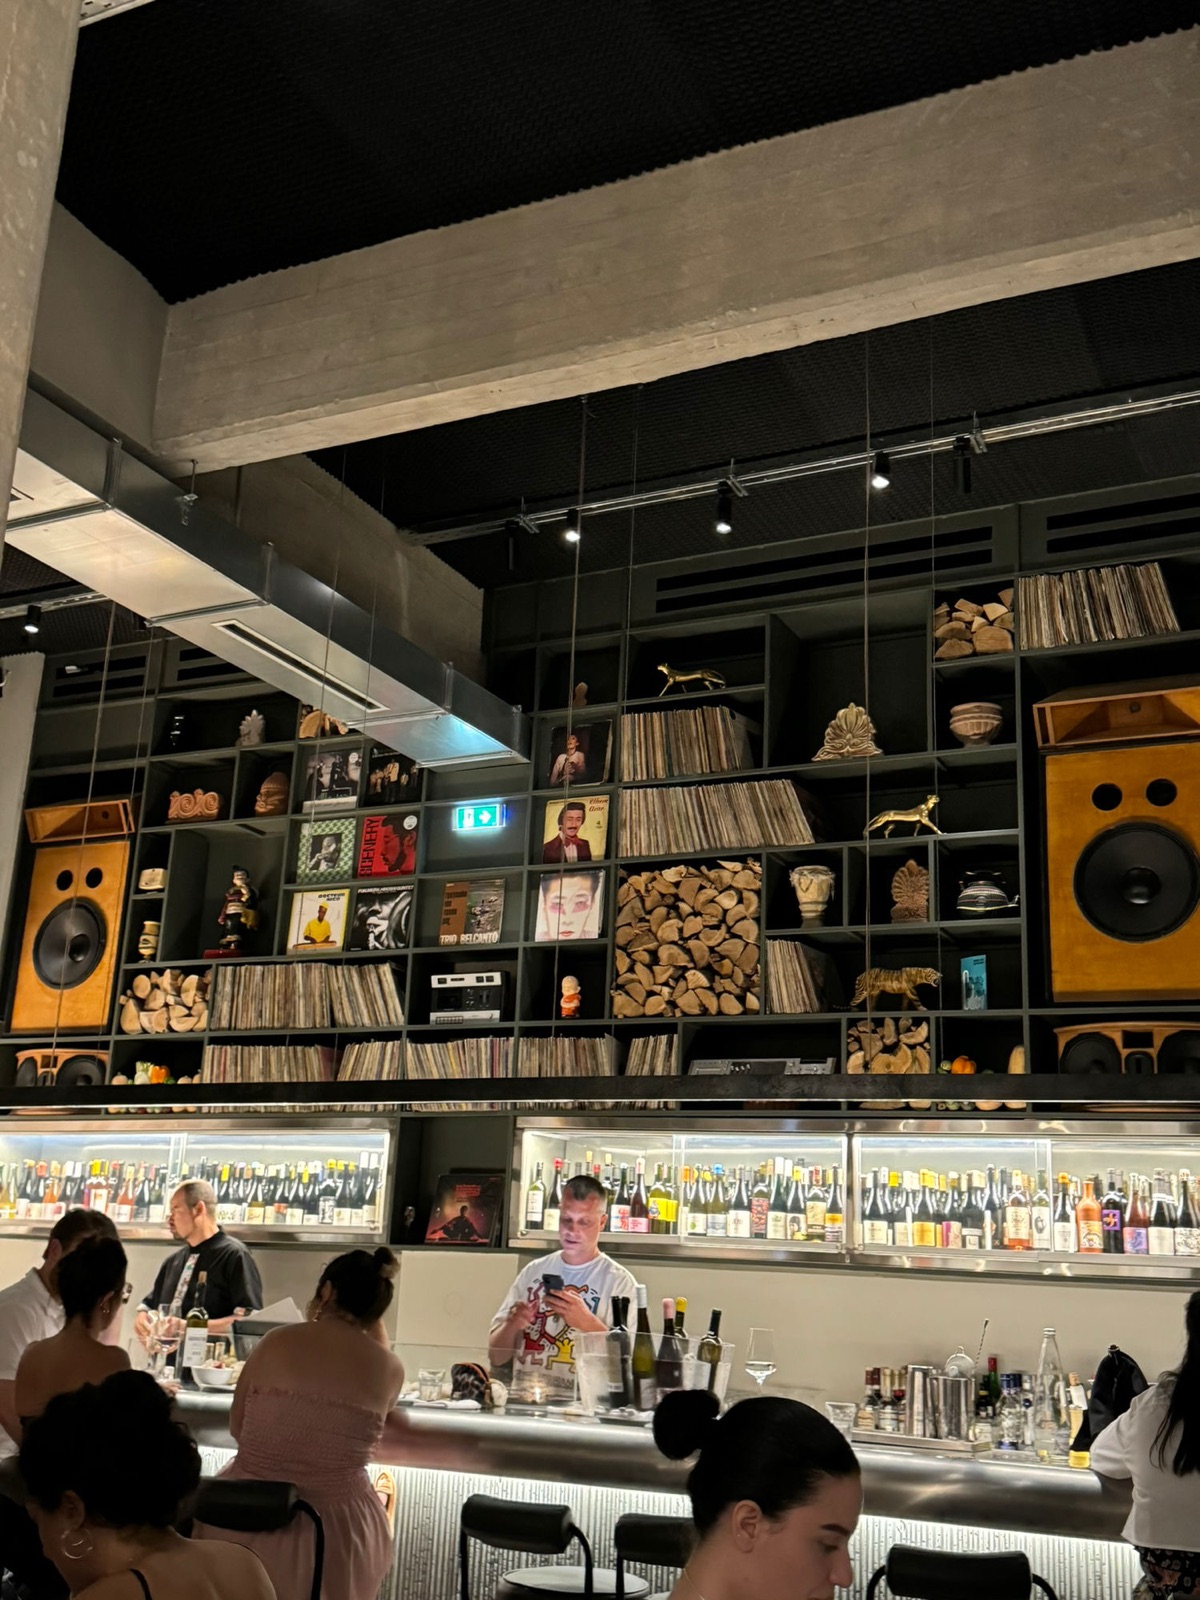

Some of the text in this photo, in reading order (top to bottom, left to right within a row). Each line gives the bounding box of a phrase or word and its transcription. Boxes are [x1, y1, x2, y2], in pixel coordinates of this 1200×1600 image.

[359, 817, 380, 877] SCENERY
[439, 931, 498, 946] TRIO BELCANTO
